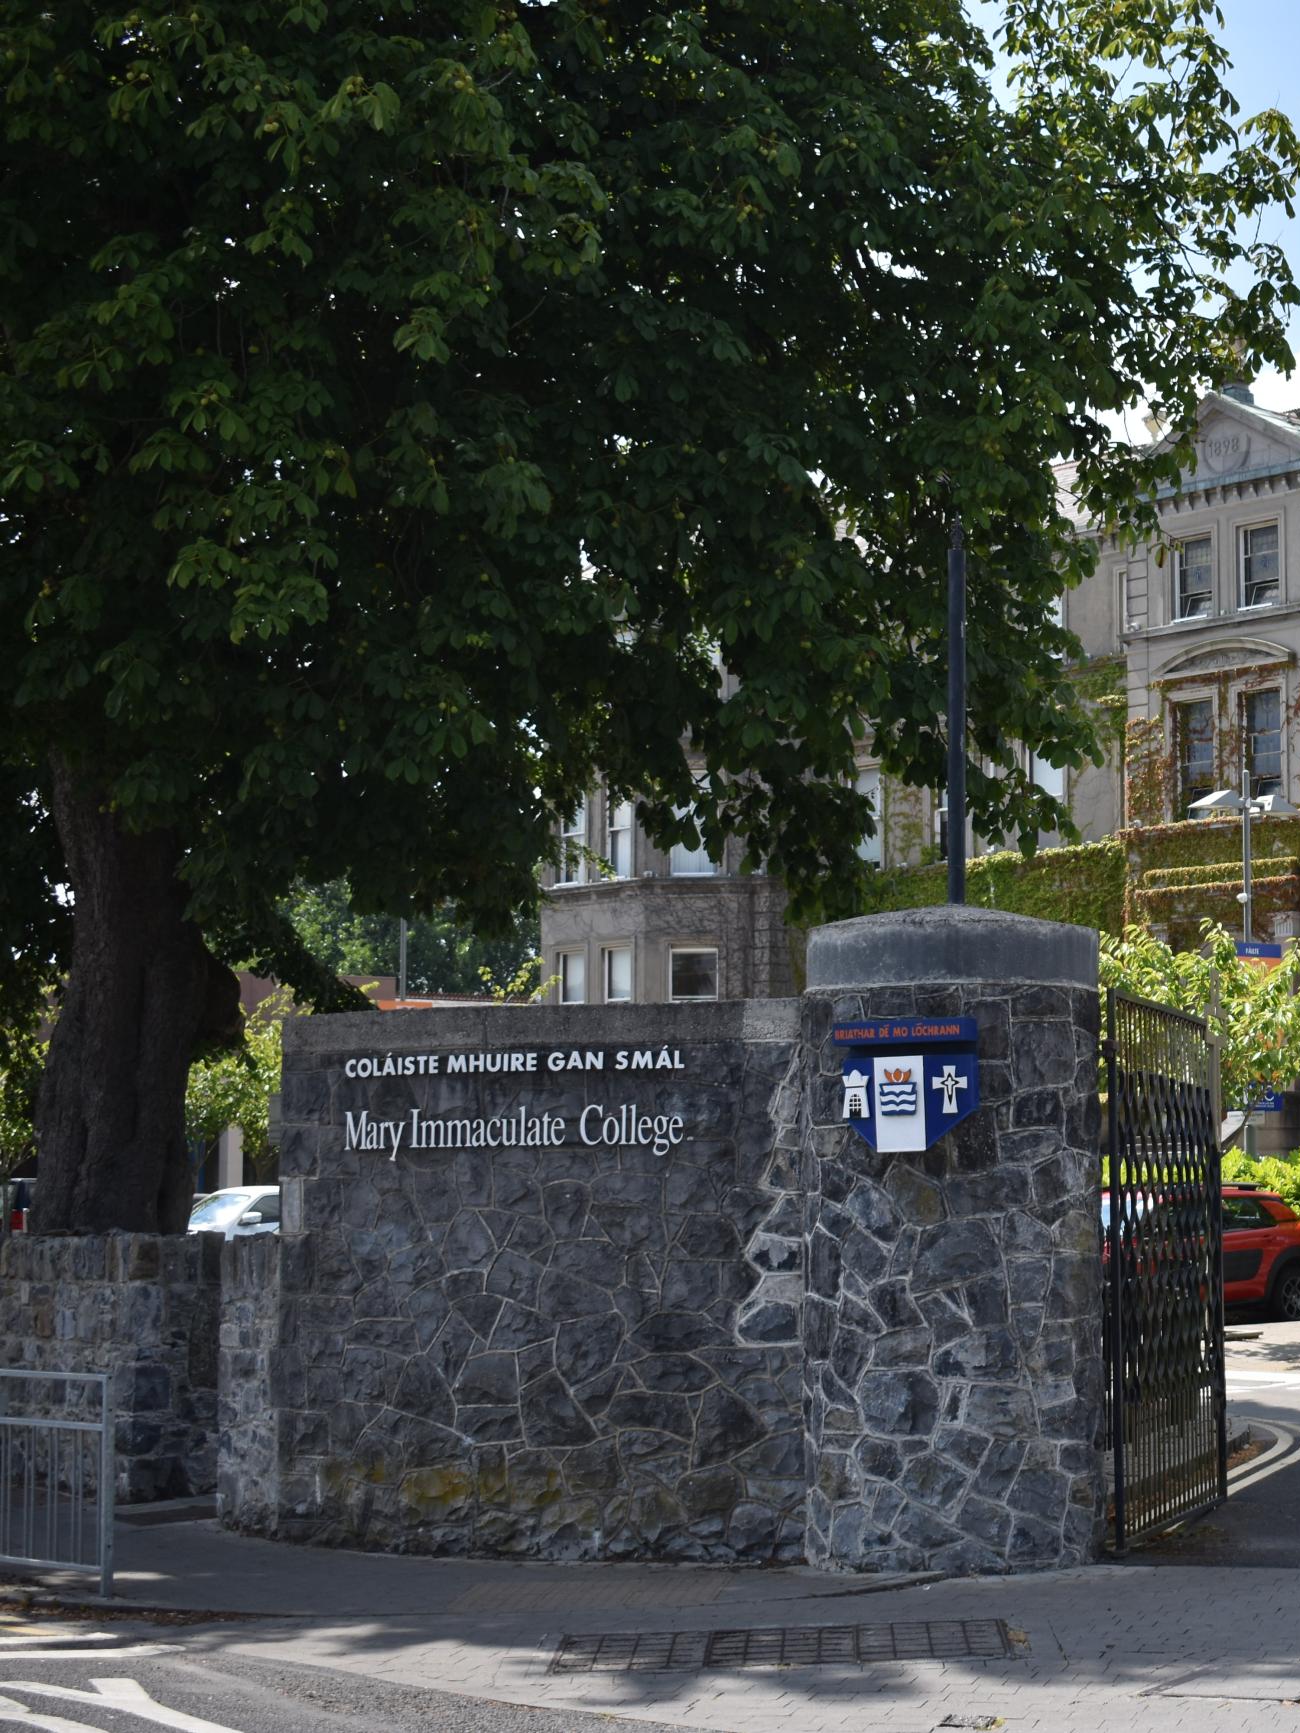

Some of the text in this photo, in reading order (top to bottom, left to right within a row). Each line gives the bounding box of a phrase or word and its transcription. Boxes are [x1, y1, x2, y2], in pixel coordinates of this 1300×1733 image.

[834, 1029, 876, 1041] BRIATHAR
[893, 1025, 908, 1037] MO
[345, 1045, 685, 1078] COLÁISTE MHUIRE GAN SMÁL
[344, 1104, 684, 1162] Mary Immaculate College
